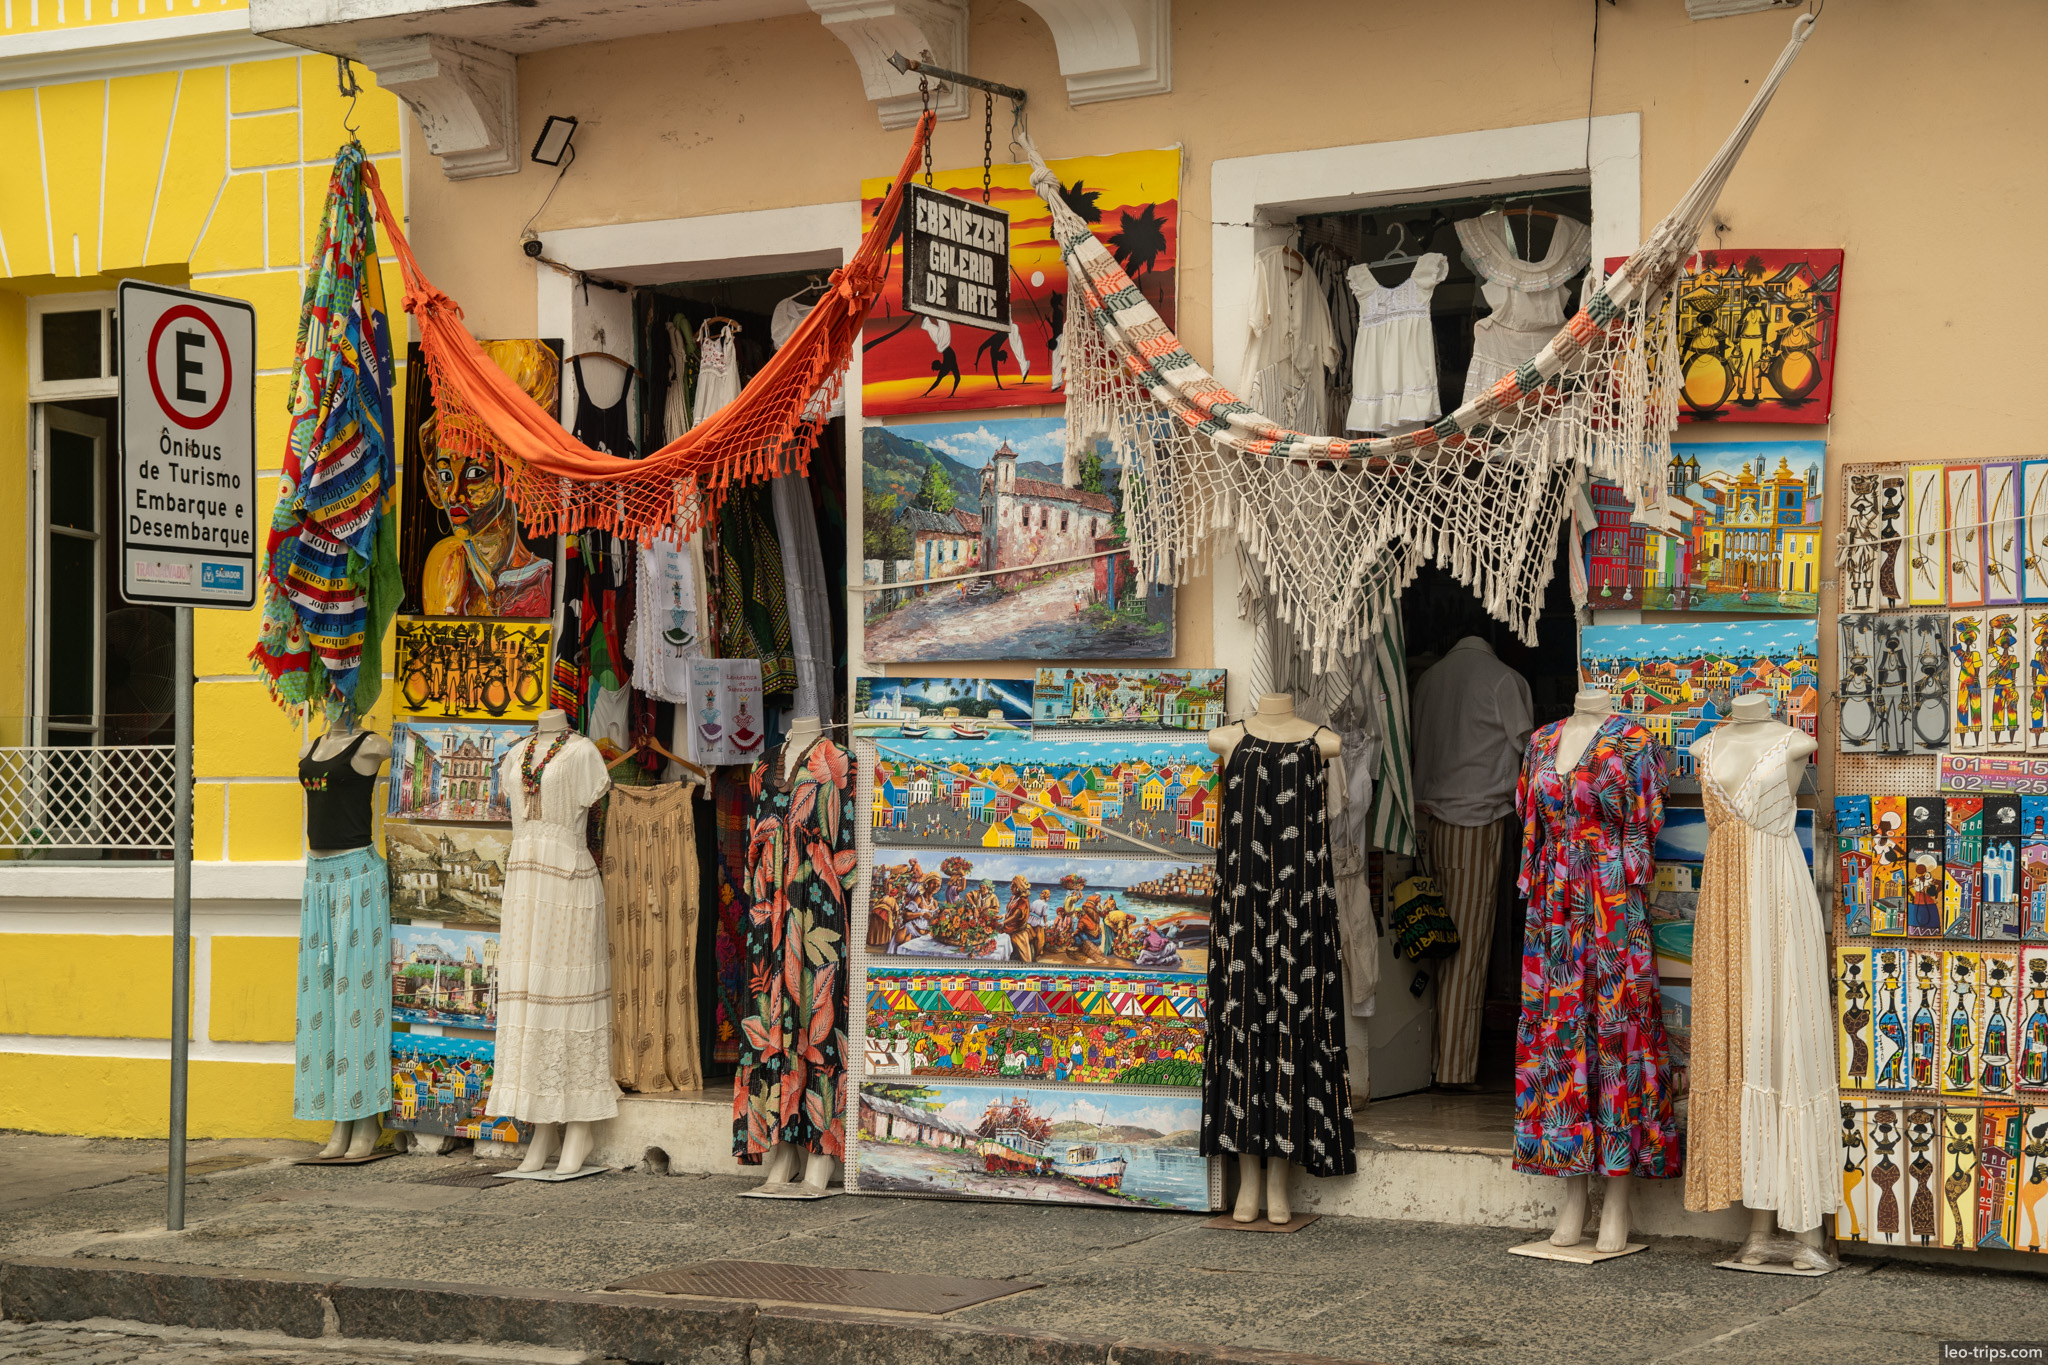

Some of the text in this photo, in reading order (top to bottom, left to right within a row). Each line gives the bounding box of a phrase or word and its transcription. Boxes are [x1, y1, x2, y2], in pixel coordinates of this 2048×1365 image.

[916, 196, 1005, 255] EBENÉZER
[929, 240, 994, 285] GALERIA
[925, 272, 997, 318] DE ARTE
[176, 330, 207, 404] E
[159, 427, 221, 461] Ônibus
[139, 460, 240, 489] de Turismo
[136, 488, 243, 520] Embarque e
[130, 515, 249, 548] Desembarque
[215, 570, 240, 579] SALVADOR
[1951, 757, 1980, 772] 01
[1950, 775, 1982, 791] 02
[2015, 779, 2048, 794] 25
